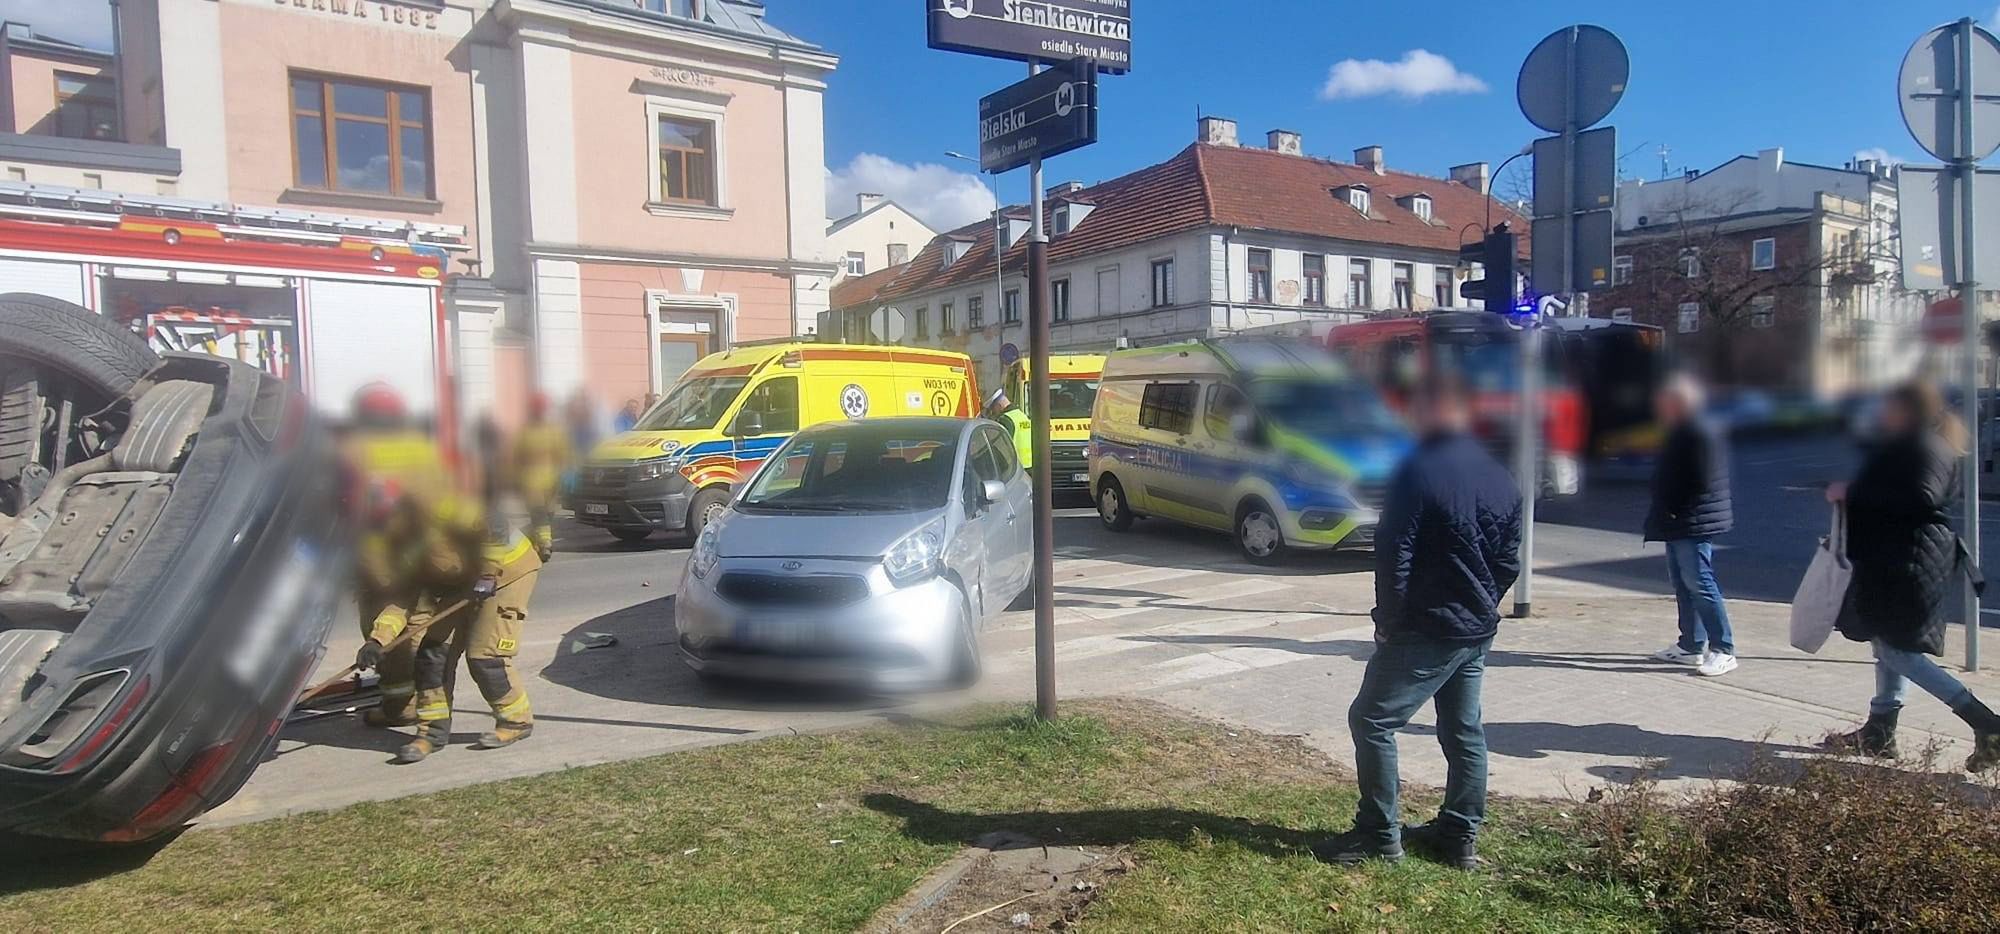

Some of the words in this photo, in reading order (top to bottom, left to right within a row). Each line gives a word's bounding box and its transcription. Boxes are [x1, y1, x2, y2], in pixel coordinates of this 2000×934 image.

[379, 4, 437, 30] 1882
[1003, 0, 1128, 39] Sienkiewicza
[1041, 39, 1073, 54] osiedle
[1075, 42, 1097, 58] Stare
[1100, 46, 1128, 62] Miasto
[981, 109, 1026, 143] Bielska
[1146, 448, 1184, 473] POLICJA
